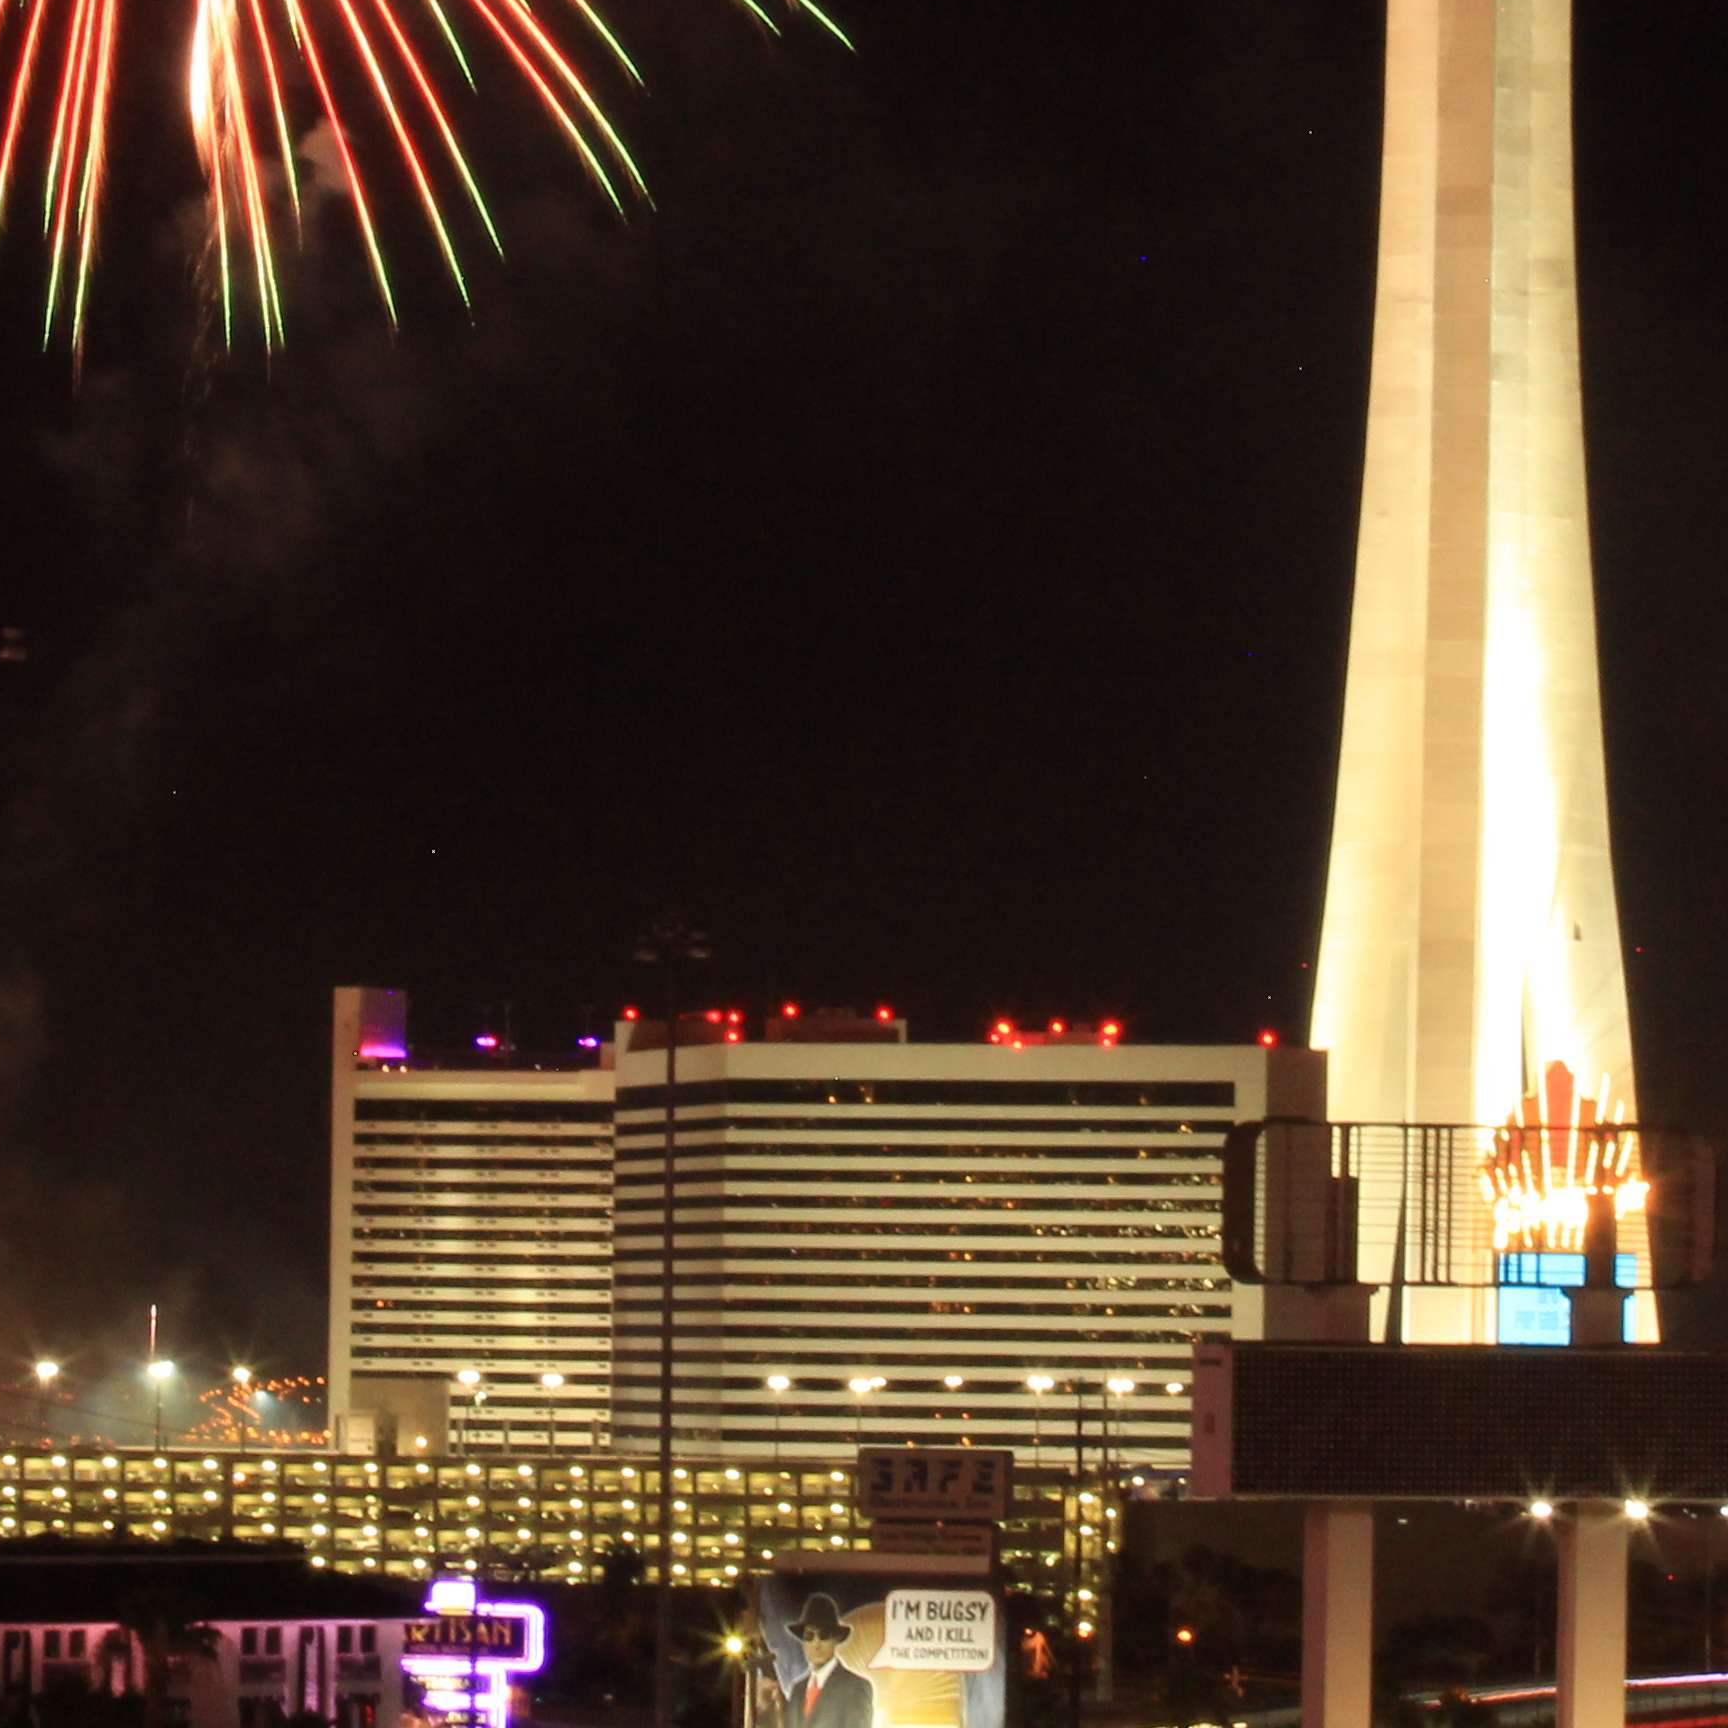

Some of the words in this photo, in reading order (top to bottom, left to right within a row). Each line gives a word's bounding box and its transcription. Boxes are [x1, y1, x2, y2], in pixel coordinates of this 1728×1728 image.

[871, 1457, 995, 1495] SAFE
[891, 1600, 920, 1621] I'M
[927, 1600, 989, 1622] BUGSY
[402, 1619, 513, 1645] RTISAN
[906, 1626, 934, 1642] AND
[946, 1627, 974, 1643] KILL
[891, 1647, 911, 1659] THE
